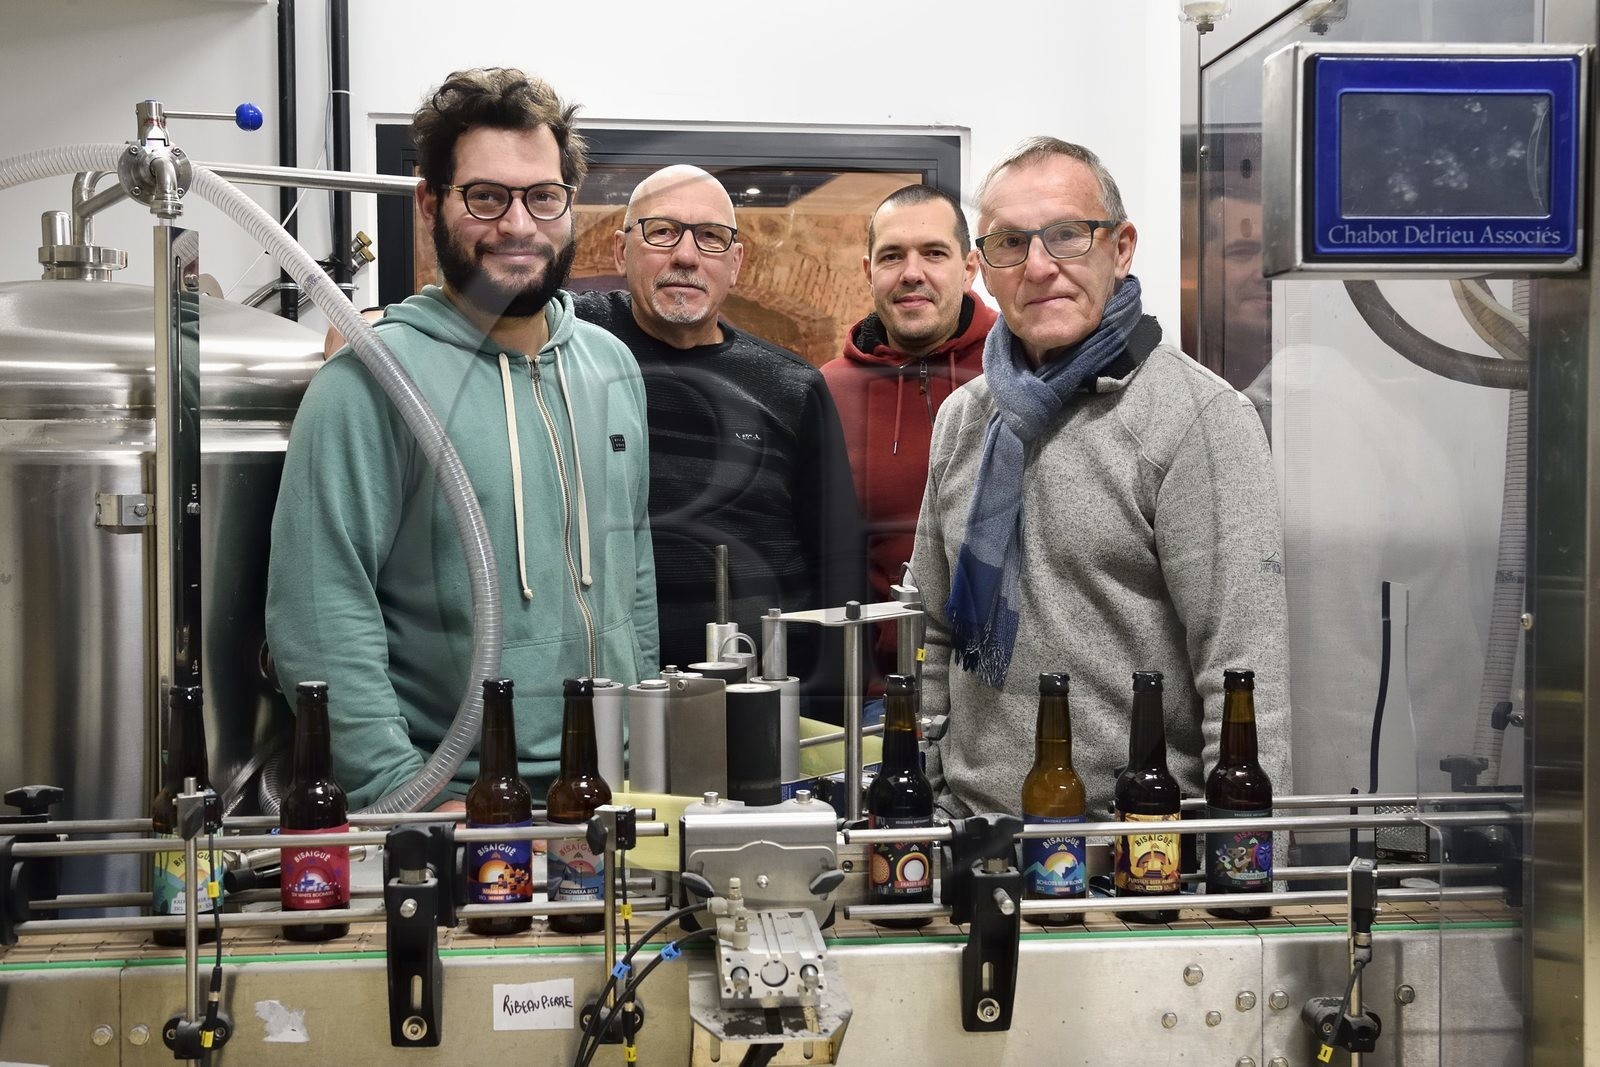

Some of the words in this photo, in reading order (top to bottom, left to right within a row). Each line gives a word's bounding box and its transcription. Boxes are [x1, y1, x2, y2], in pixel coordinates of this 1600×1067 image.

[1328, 225, 1399, 245] Chabot
[1404, 225, 1475, 245] Delrieu
[1480, 225, 1562, 245] Associés
